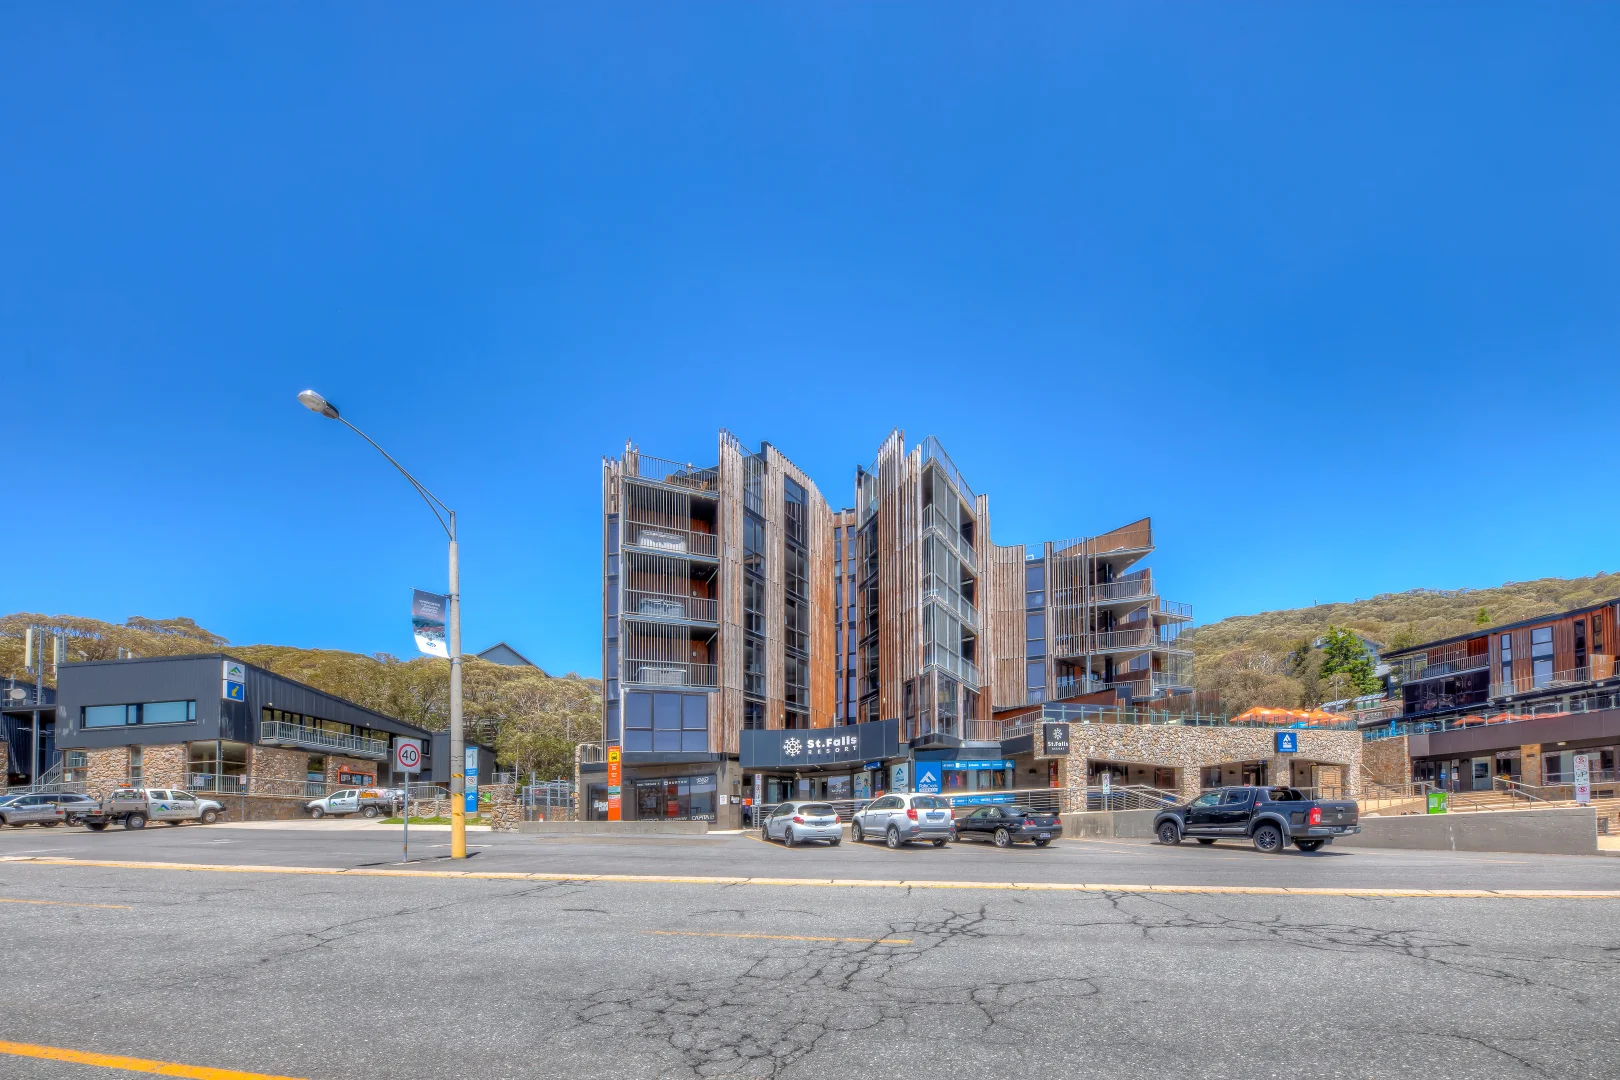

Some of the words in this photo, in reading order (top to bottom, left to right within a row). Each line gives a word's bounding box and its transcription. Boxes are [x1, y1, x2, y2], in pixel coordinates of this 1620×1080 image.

[807, 735, 858, 749] St.Falls
[401, 749, 417, 762] 40
[808, 746, 858, 755] RESORT
